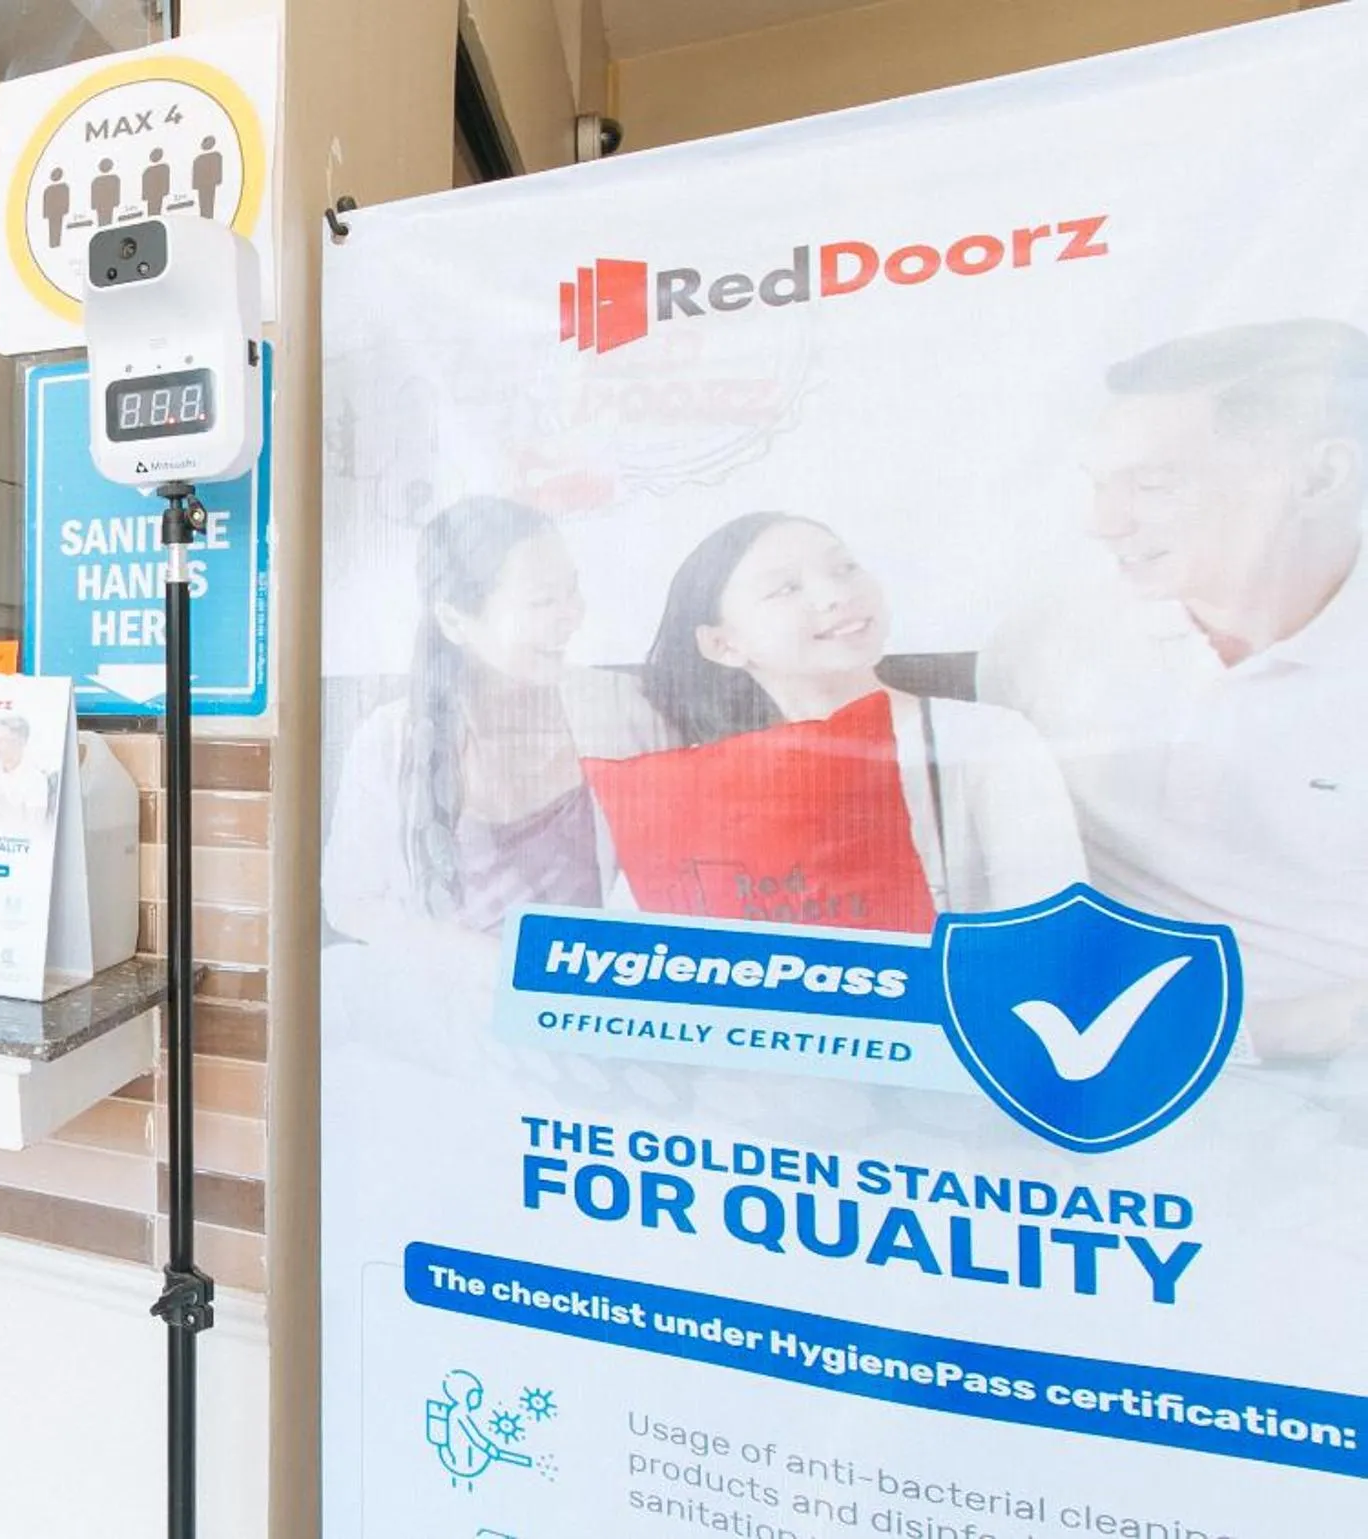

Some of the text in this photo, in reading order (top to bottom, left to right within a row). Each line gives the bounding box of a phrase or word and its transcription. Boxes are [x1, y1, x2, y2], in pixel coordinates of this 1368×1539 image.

[85, 104, 184, 142] MAX 4
[656, 215, 1109, 322] RedDoorz
[60, 511, 230, 556] SANITE
[91, 609, 168, 647] HER
[546, 940, 908, 1000] HygienePass
[537, 1010, 913, 1063] OFFICIALLY CERTIFIED
[521, 1116, 1194, 1231] THE GOLDEN STANDARD
[523, 1154, 1203, 1305] FOR QUALITY
[428, 1264, 1358, 1450] The checklist under HygienePass certification:
[629, 1411, 731, 1457] Usage
[741, 1443, 777, 1466] of
[786, 1451, 1046, 1523] anti-bacterial
[629, 1451, 780, 1507] products
[793, 1491, 858, 1526] and
